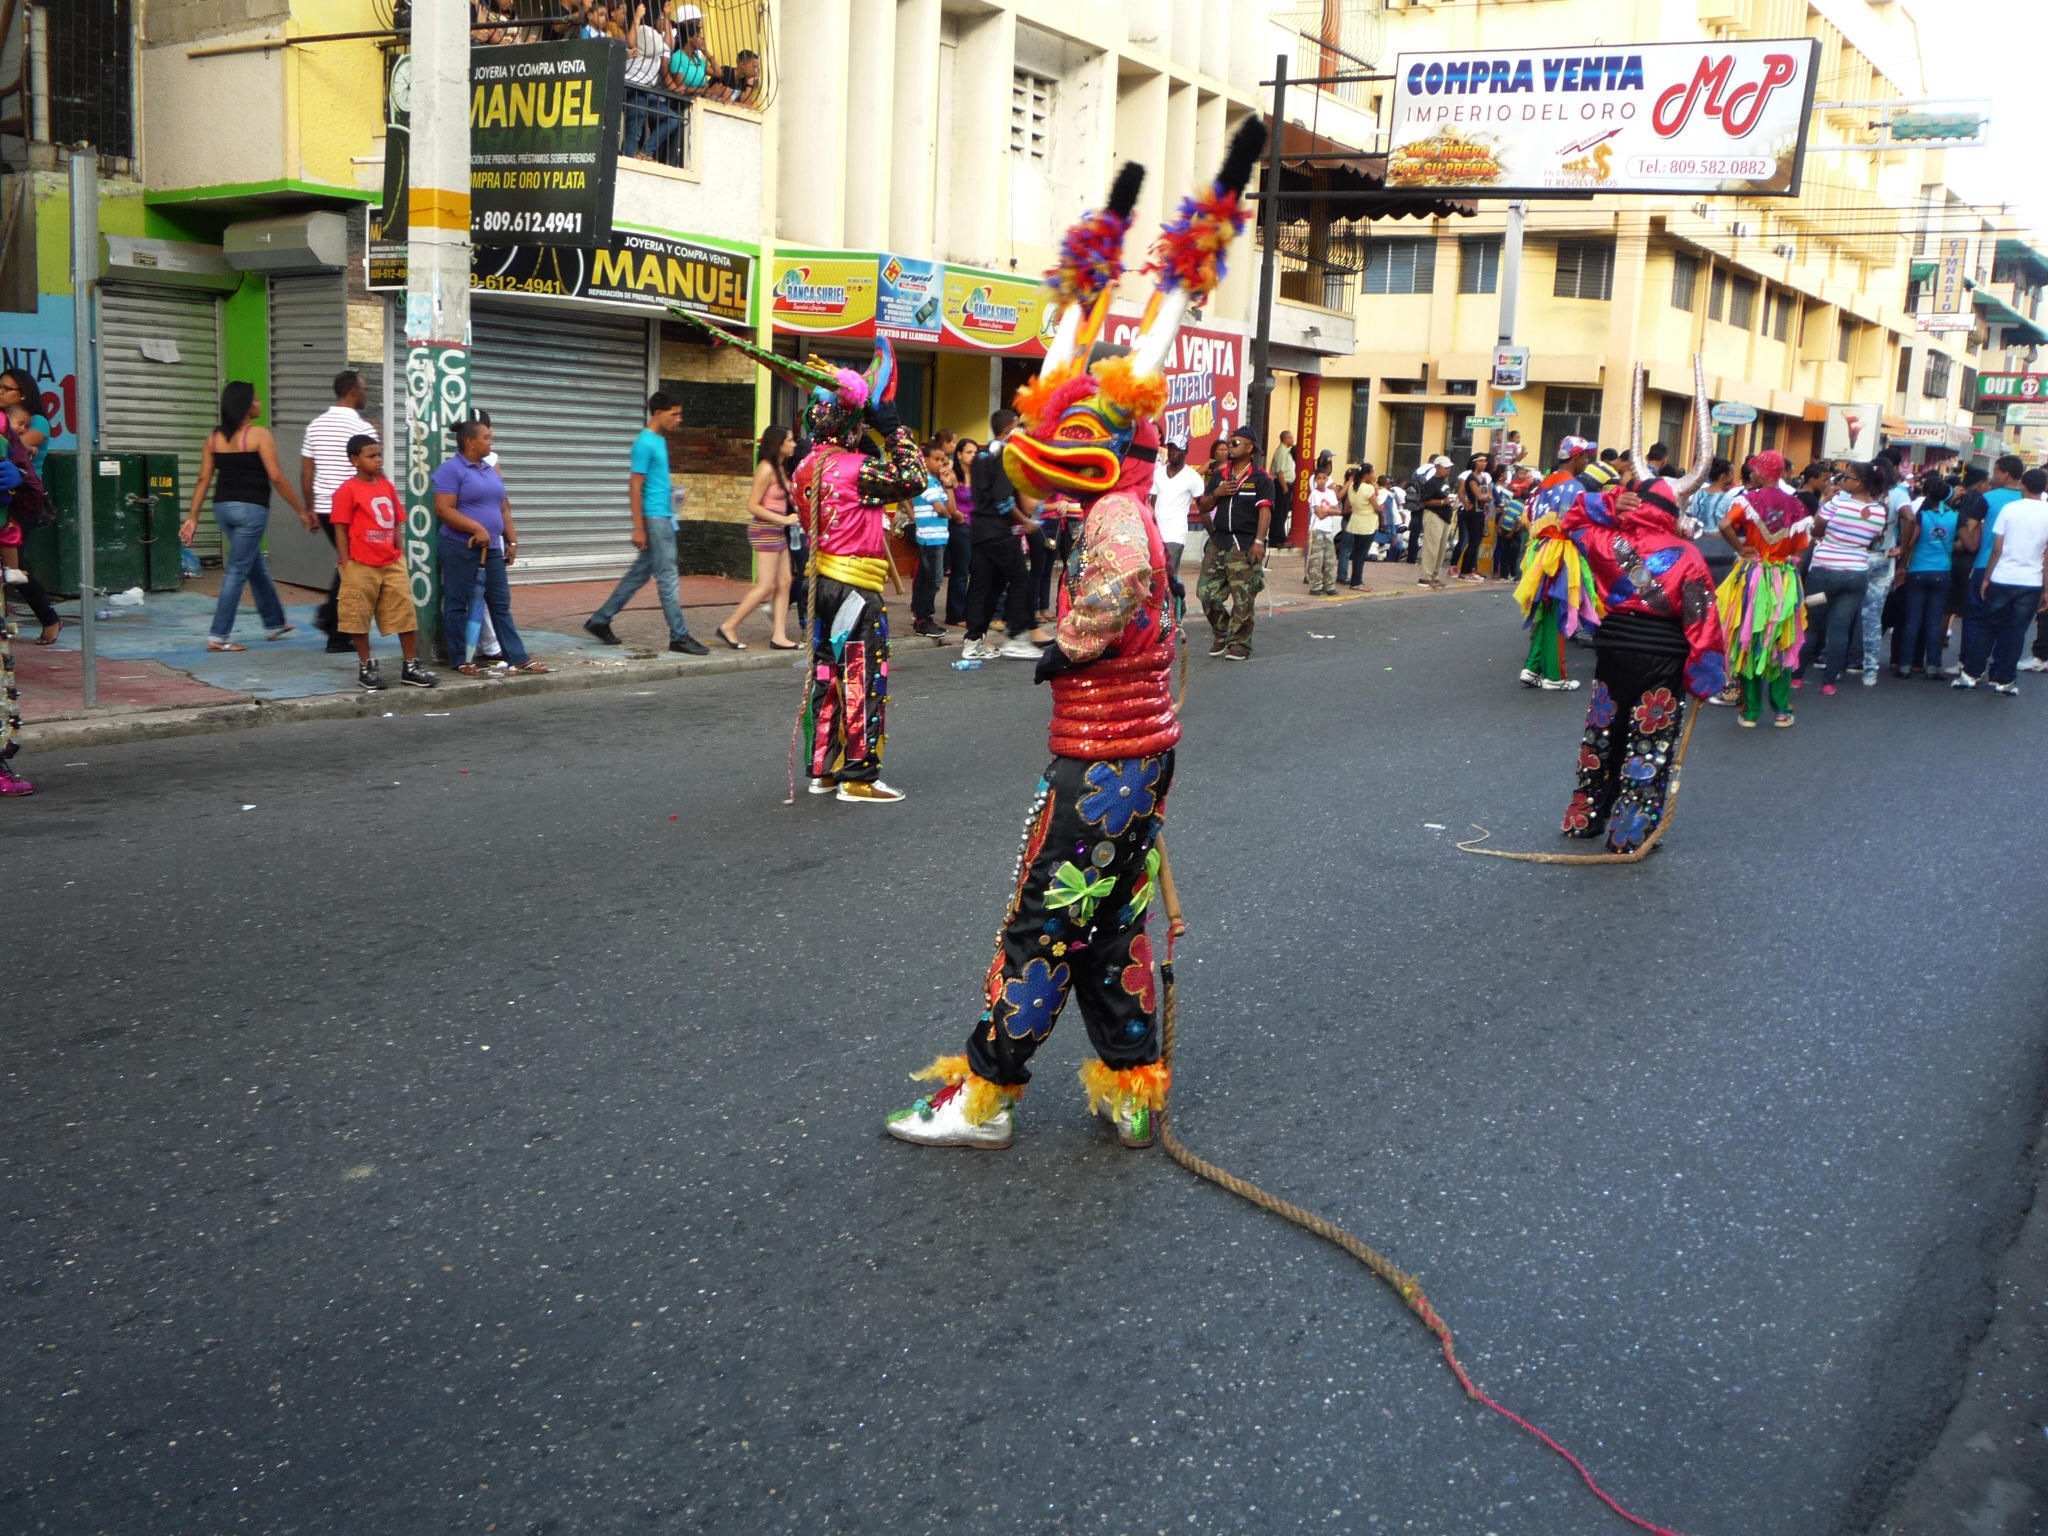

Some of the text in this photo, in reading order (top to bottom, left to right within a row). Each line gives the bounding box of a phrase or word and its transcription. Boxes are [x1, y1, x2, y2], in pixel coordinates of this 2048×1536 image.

[474, 59, 586, 80] JOYERIA Y COMPRA VENTA
[1407, 55, 1645, 96] COMPRA VENTA
[470, 79, 600, 129] MANUEL
[1406, 102, 1636, 122] IMPERIO DEL ORO
[485, 153, 493, 164] DE
[550, 153, 569, 164] SOBRE
[570, 152, 596, 164] PRENDAS
[1407, 145, 1490, 158] MAS DINERO
[1392, 162, 1498, 176] POR SU PRENDA
[1638, 159, 1767, 175] Tel.: 809.582.0882
[503, 171, 516, 188] DE
[519, 171, 540, 189] ORO
[543, 172, 551, 188] Y
[552, 171, 586, 189] PLATA
[483, 211, 582, 233] 809.612.4941
[624, 236, 731, 268] JOYERIA Y COMPRA VENTA
[591, 249, 747, 308] MANUEL
[1942, 240, 1958, 312] GIMNASIO
[787, 285, 845, 303] BANCA SURIEL
[974, 302, 995, 319] BANCA
[995, 305, 1016, 322] SURIEL
[876, 328, 939, 343] CENTRO DE LLAMADAS
[1182, 335, 1235, 377] VENTA
[1984, 376, 2017, 395] OUT
[1299, 396, 1315, 502] COMPRO ORO
[408, 504, 432, 607] ORO
